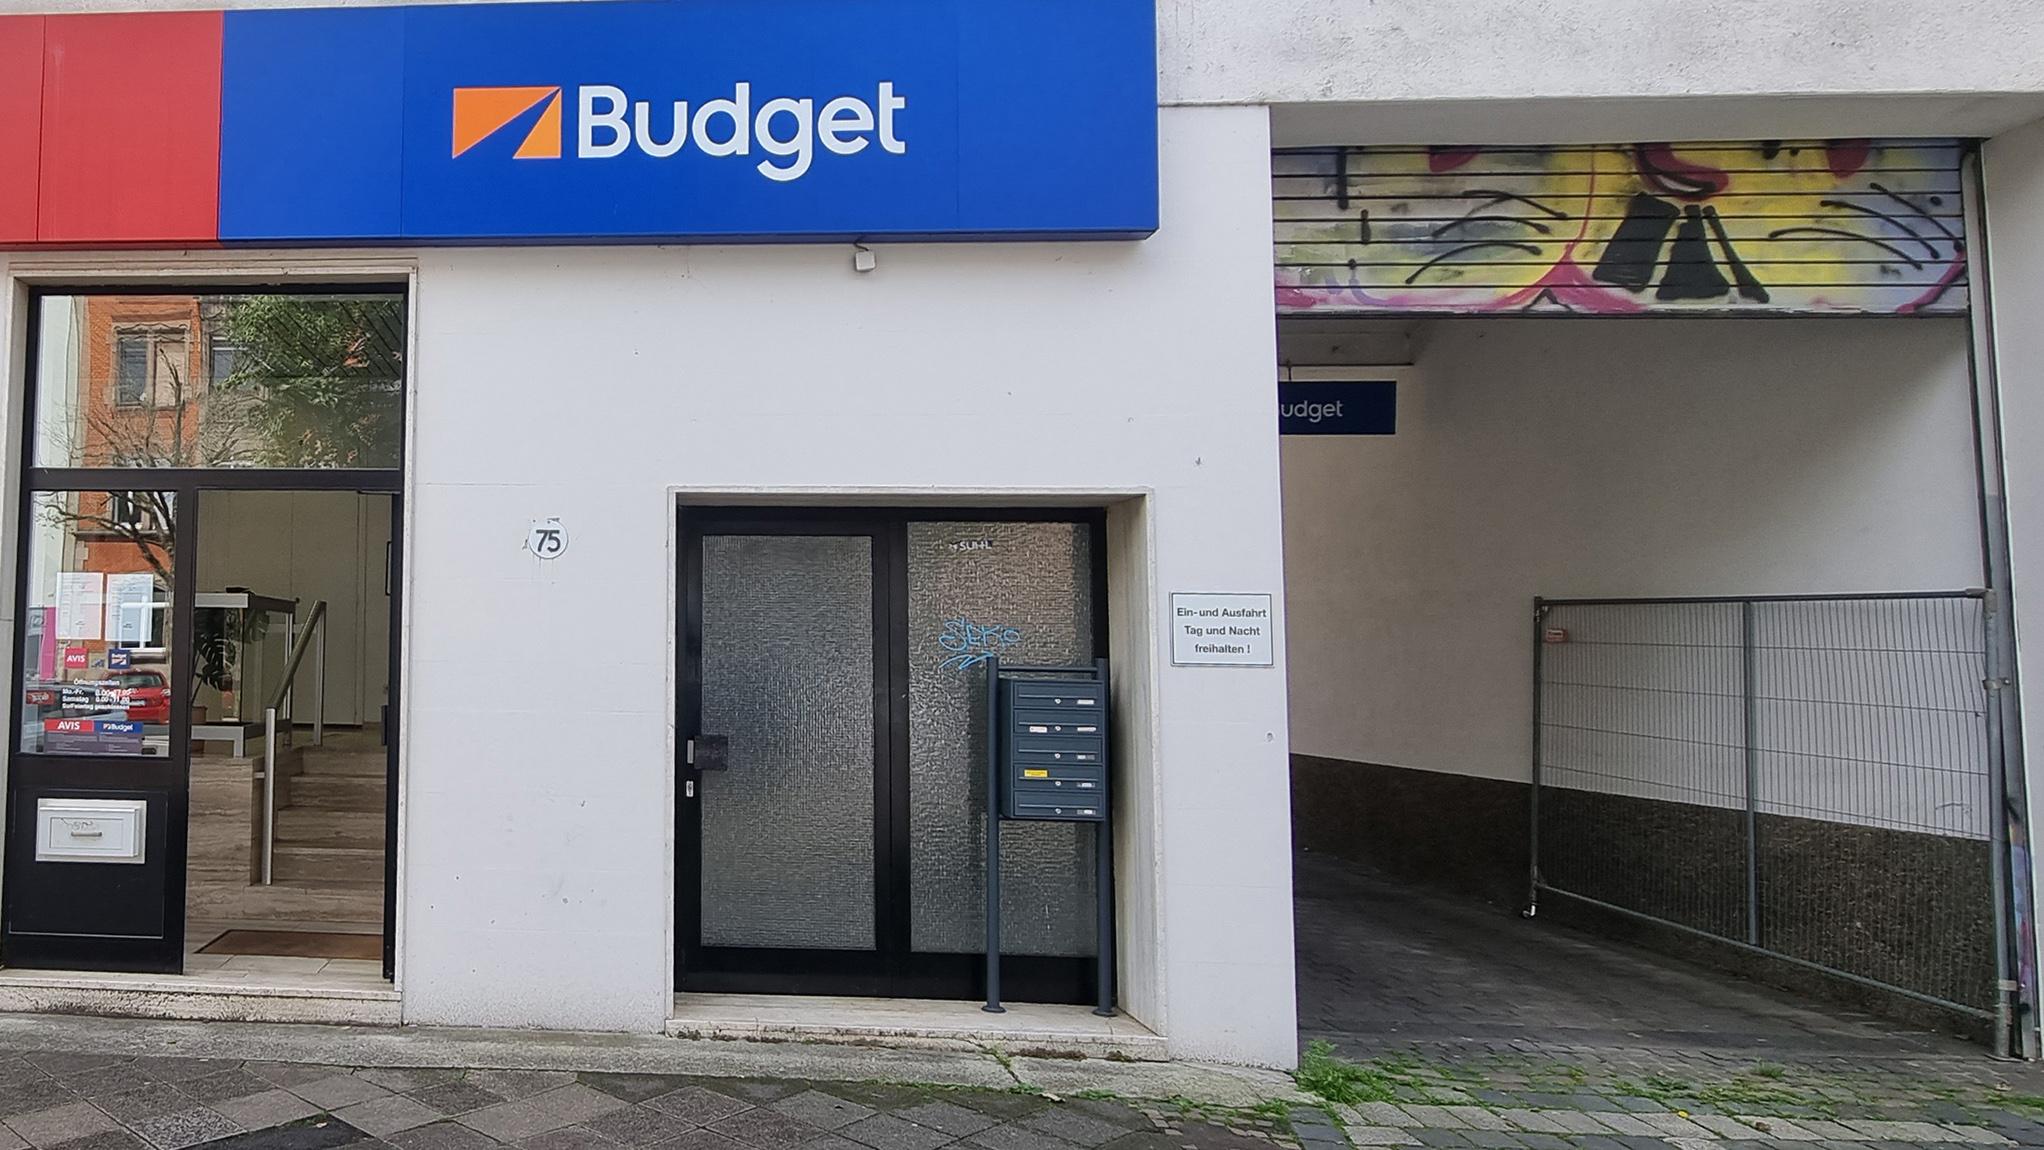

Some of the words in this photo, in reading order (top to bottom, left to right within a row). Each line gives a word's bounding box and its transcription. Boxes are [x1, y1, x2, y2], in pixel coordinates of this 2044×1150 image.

[578, 82, 906, 181] Budget
[1281, 400, 1343, 422] udget
[536, 529, 561, 552] 75
[1221, 608, 1267, 618] Ausfahrt
[1184, 625, 1203, 637] Tag
[1205, 626, 1226, 636] und
[1229, 626, 1260, 636] Nacht
[1194, 644, 1245, 654] freihalten
[66, 655, 86, 663] AVIS
[57, 721, 80, 730] AVIS
[111, 724, 133, 732] Budget
